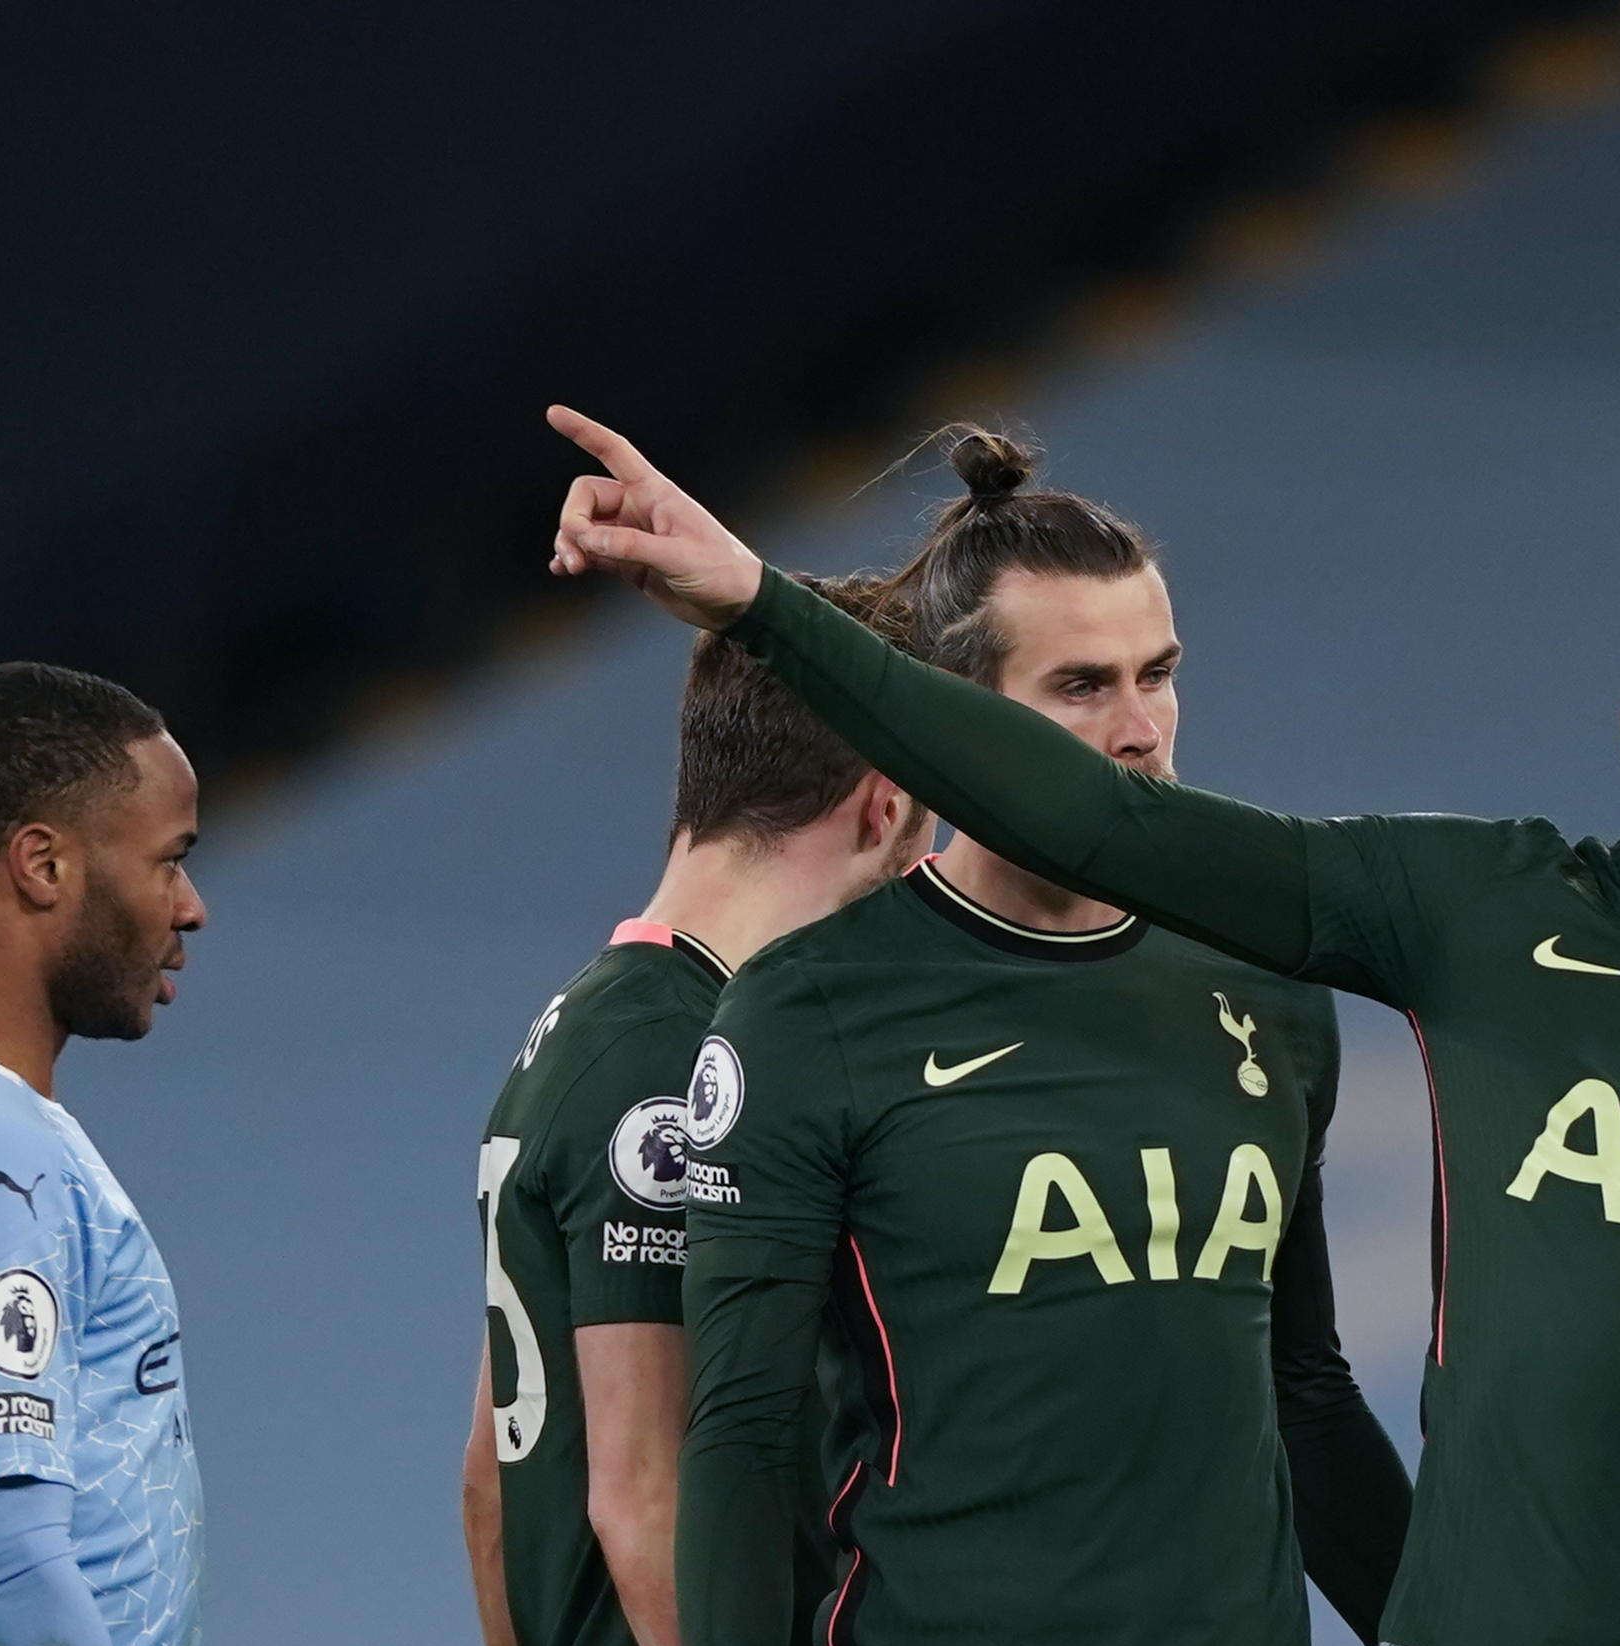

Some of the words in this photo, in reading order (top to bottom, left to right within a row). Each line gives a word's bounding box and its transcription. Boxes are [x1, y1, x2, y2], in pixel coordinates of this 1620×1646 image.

[690, 1160, 730, 1185] room
[987, 1143, 1283, 1294] AIA
[603, 1221, 639, 1244] No
[603, 1241, 637, 1262] for
[640, 1245, 689, 1267] racis
